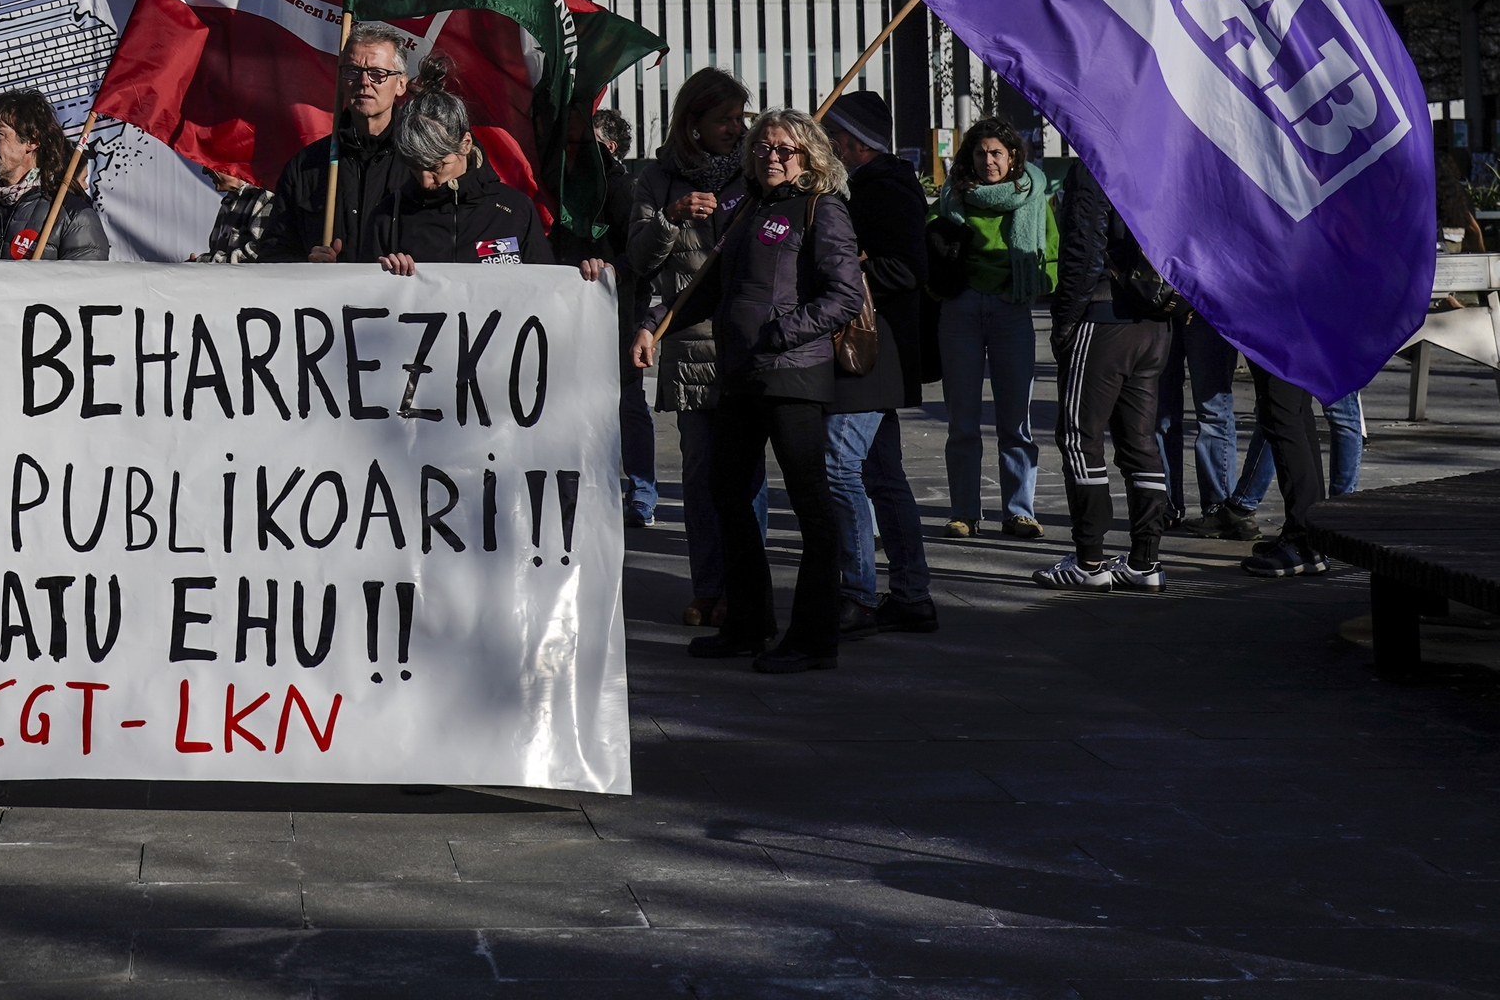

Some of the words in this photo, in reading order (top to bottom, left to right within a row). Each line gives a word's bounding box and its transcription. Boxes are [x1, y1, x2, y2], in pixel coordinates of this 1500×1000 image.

[763, 219, 787, 235] LAB
[22, 304, 548, 428] BEHARREZKO
[169, 576, 416, 683] EHU!!
